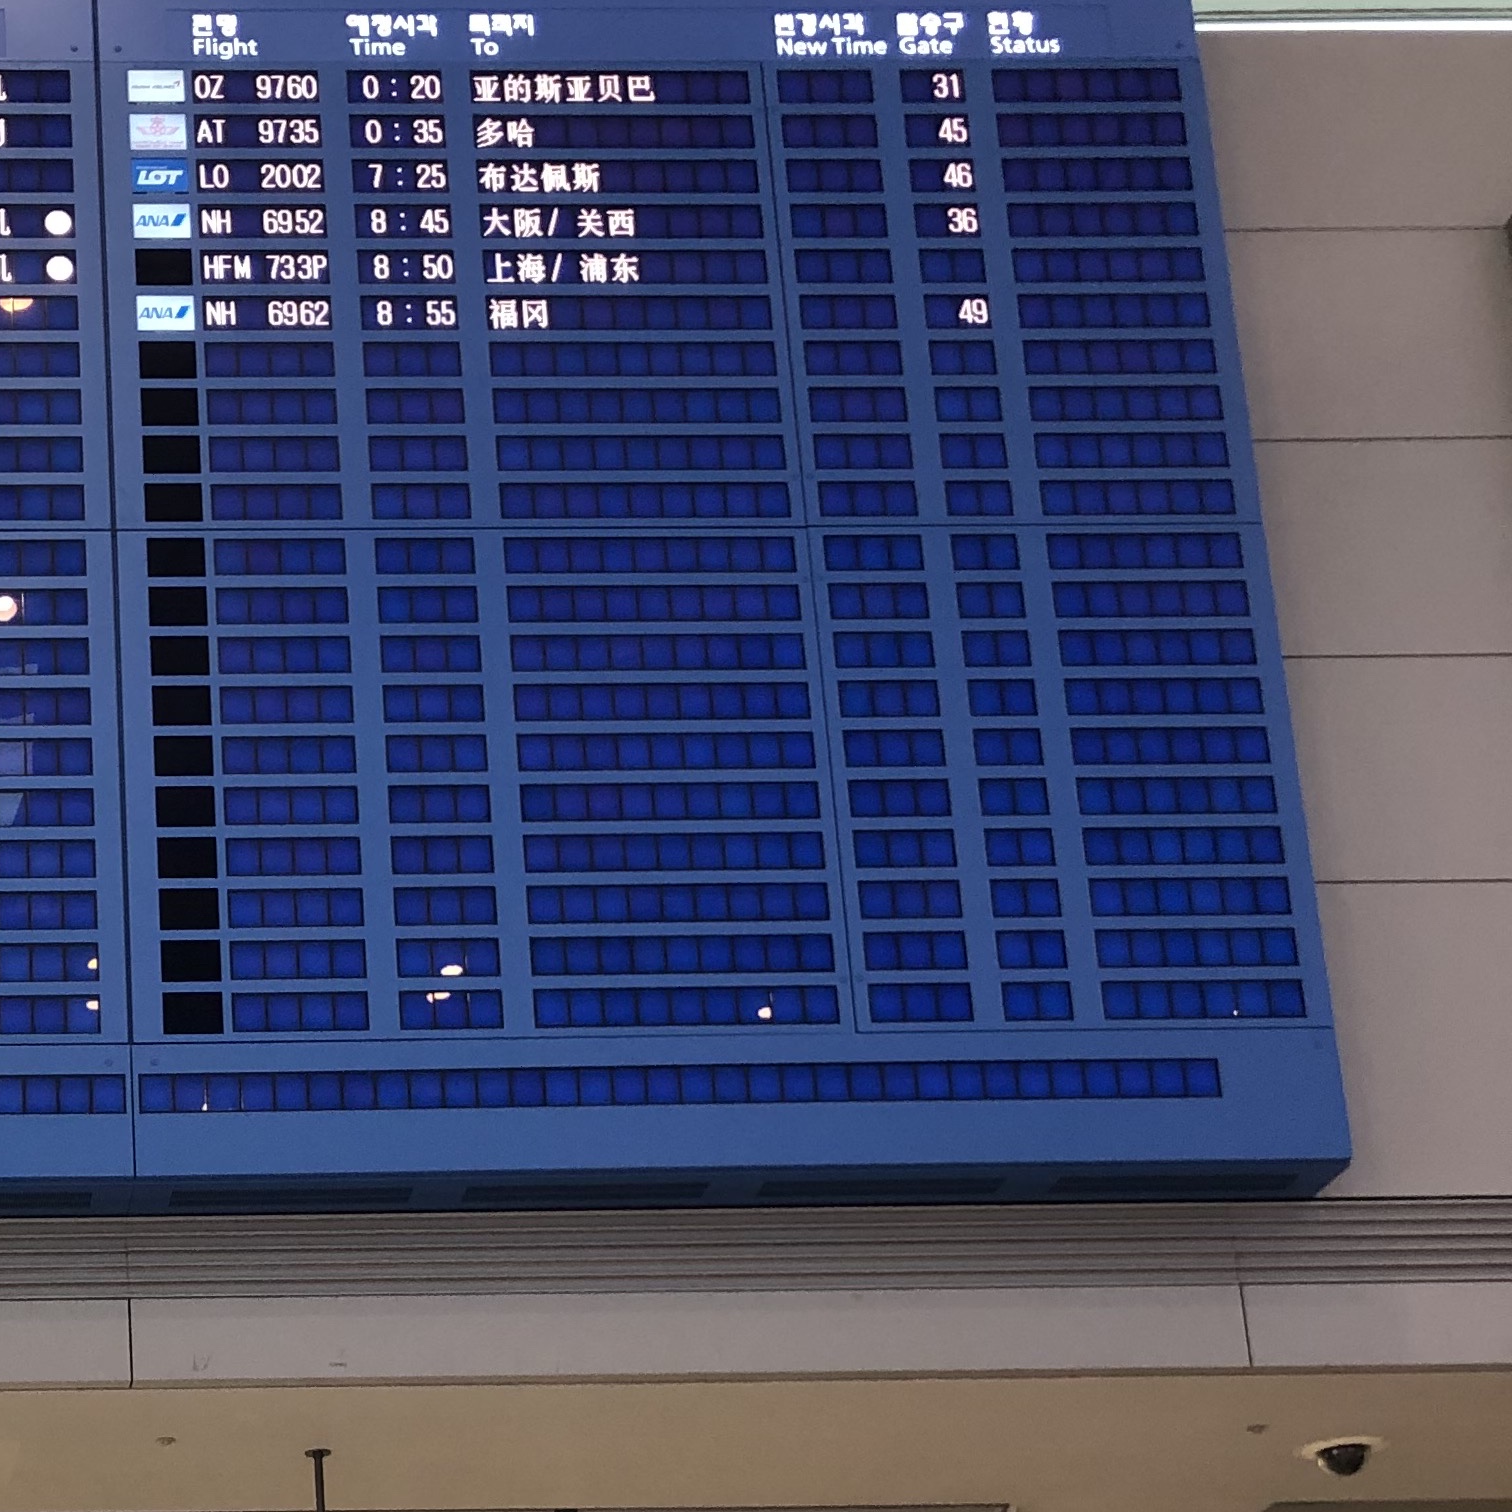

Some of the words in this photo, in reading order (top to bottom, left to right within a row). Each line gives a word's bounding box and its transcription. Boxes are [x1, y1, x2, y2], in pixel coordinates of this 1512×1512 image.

[193, 37, 258, 60] Flight
[349, 38, 406, 56] Time
[470, 37, 499, 56] To
[776, 34, 828, 56] New
[830, 36, 888, 55] Time
[898, 34, 953, 55] Gate
[990, 35, 1061, 54] Status
[194, 74, 224, 99] OZ
[255, 74, 318, 100] 9760
[473, 73, 656, 104] 亚的斯亚贝巴
[932, 73, 960, 99] 31
[196, 119, 226, 144] AT
[258, 119, 319, 144] 9735
[476, 117, 535, 148] 多哈
[938, 117, 968, 143] 45
[136, 169, 184, 186] LOT
[199, 164, 230, 189] LO
[260, 163, 322, 189] 2002
[478, 162, 600, 193] 布达佩斯
[943, 162, 973, 188] 46
[135, 214, 170, 227] ANA
[201, 209, 232, 234] NH
[262, 209, 324, 234] 6952
[947, 207, 978, 233] 36
[203, 254, 252, 280] HFM
[265, 254, 328, 280] 733P
[138, 306, 174, 320] ANA
[205, 300, 237, 326] NH
[267, 300, 330, 326] 6962
[488, 299, 549, 330] 福冈
[958, 298, 989, 324] 49
